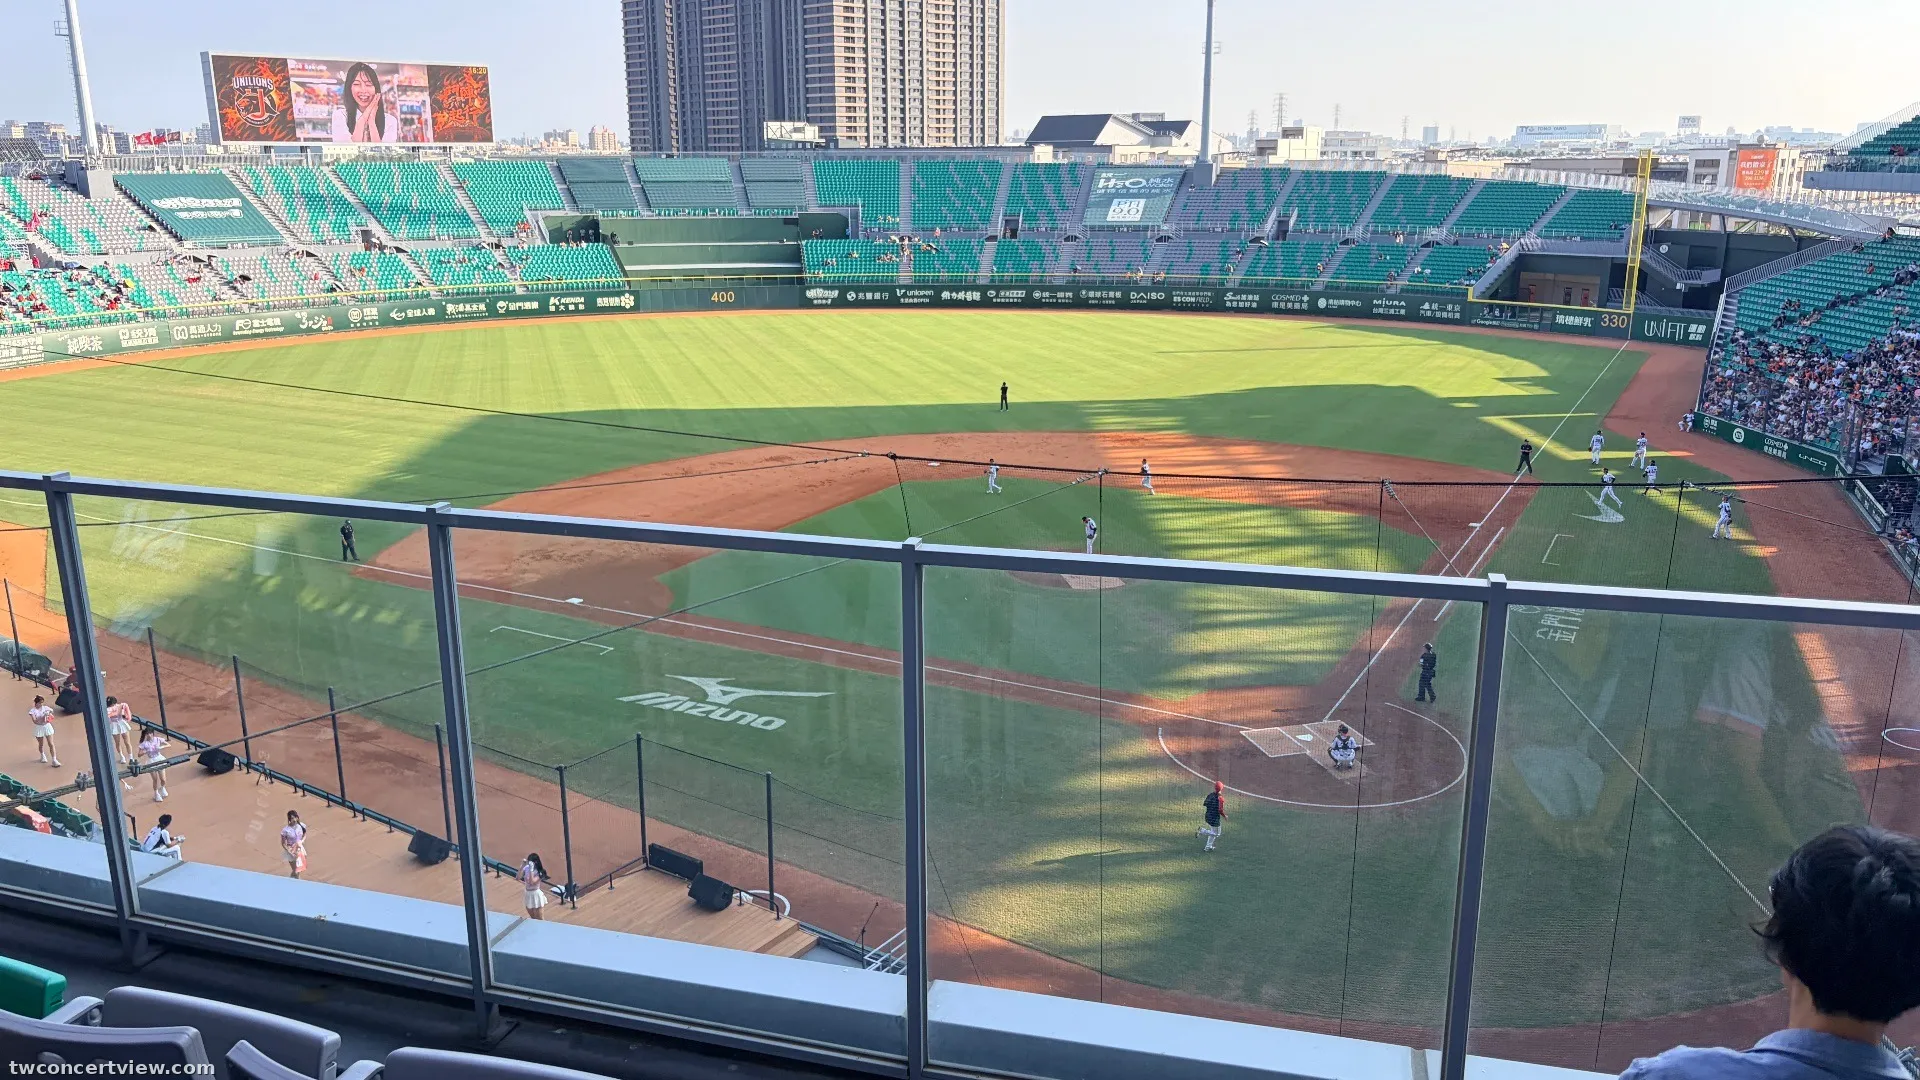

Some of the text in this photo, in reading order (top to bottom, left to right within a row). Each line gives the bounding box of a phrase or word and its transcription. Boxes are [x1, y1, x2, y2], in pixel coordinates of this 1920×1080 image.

[233, 76, 274, 90] UNILIONS
[560, 296, 585, 304] KENDA
[711, 291, 735, 303] 400
[857, 292, 889, 300] 兆豐銀行
[1130, 292, 1166, 300] DAISO
[1271, 294, 1301, 302] COSMED
[1600, 313, 1628, 328] 330
[1764, 437, 1784, 448] COSMED
